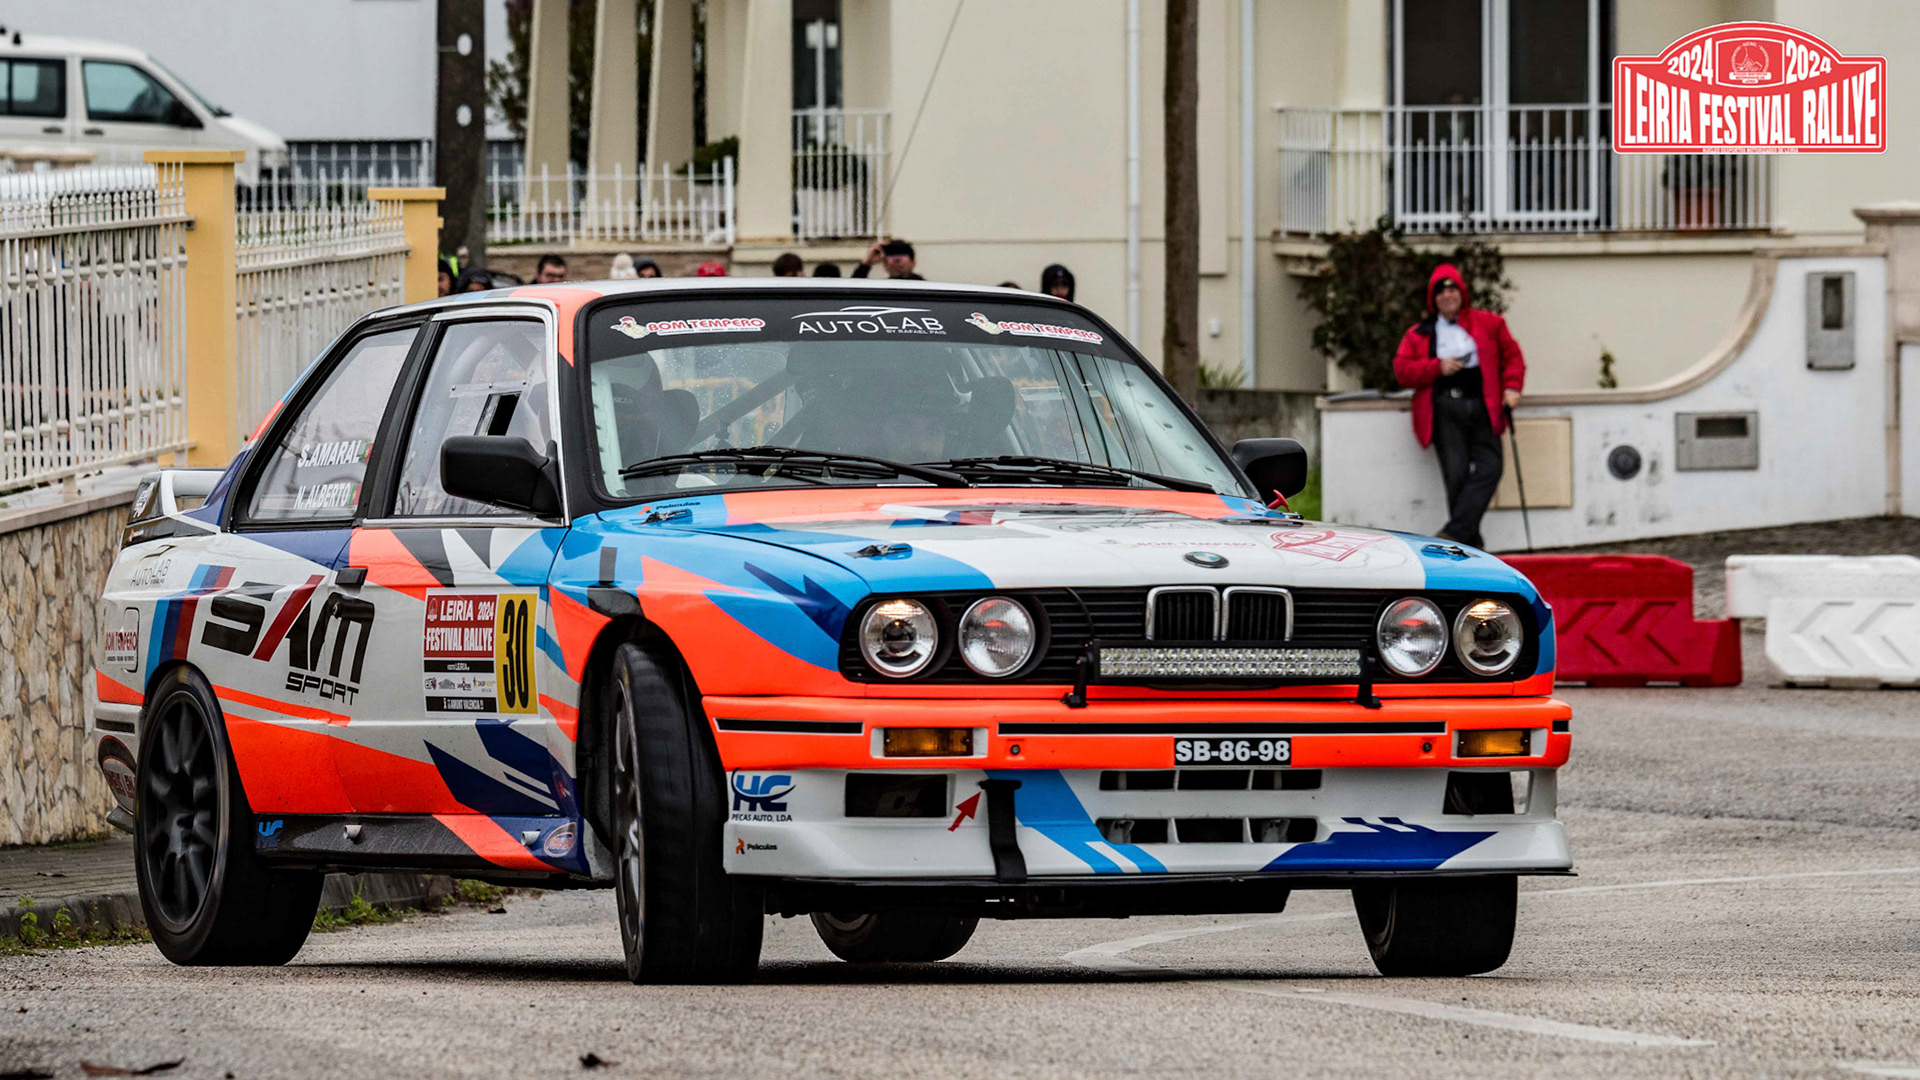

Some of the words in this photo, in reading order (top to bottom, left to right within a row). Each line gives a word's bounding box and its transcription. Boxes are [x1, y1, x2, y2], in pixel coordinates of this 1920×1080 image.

[648, 322, 687, 331] BOM
[689, 319, 763, 328] TEMPERO
[1000, 322, 1035, 331] BOM
[1036, 324, 1101, 340] TEMPERO
[440, 600, 473, 621] LEIRIA
[477, 601, 494, 620] 2024
[426, 627, 462, 651] FESTIVAL
[463, 627, 493, 651] RALLYE
[503, 599, 529, 708] 30
[285, 671, 359, 705] SPORT
[1175, 740, 1290, 761] SB-86-98
[752, 814, 775, 823] AUTO,
[776, 814, 793, 822] LDA
